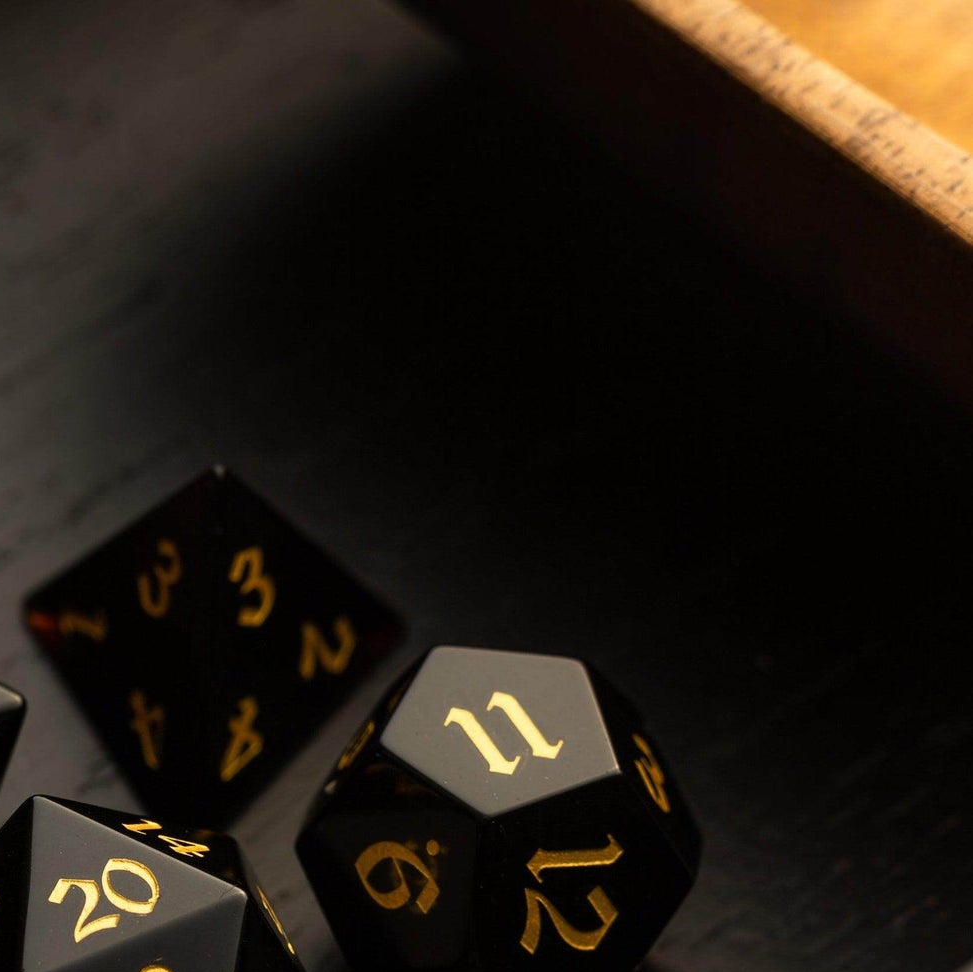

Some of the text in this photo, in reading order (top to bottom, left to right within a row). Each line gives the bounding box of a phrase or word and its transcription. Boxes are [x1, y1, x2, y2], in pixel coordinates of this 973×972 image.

[228, 546, 276, 628] 3
[298, 615, 356, 681] 2
[220, 696, 264, 783] 4
[442, 690, 566, 776] 11
[48, 858, 160, 942] 20
[521, 837, 623, 954] 12
